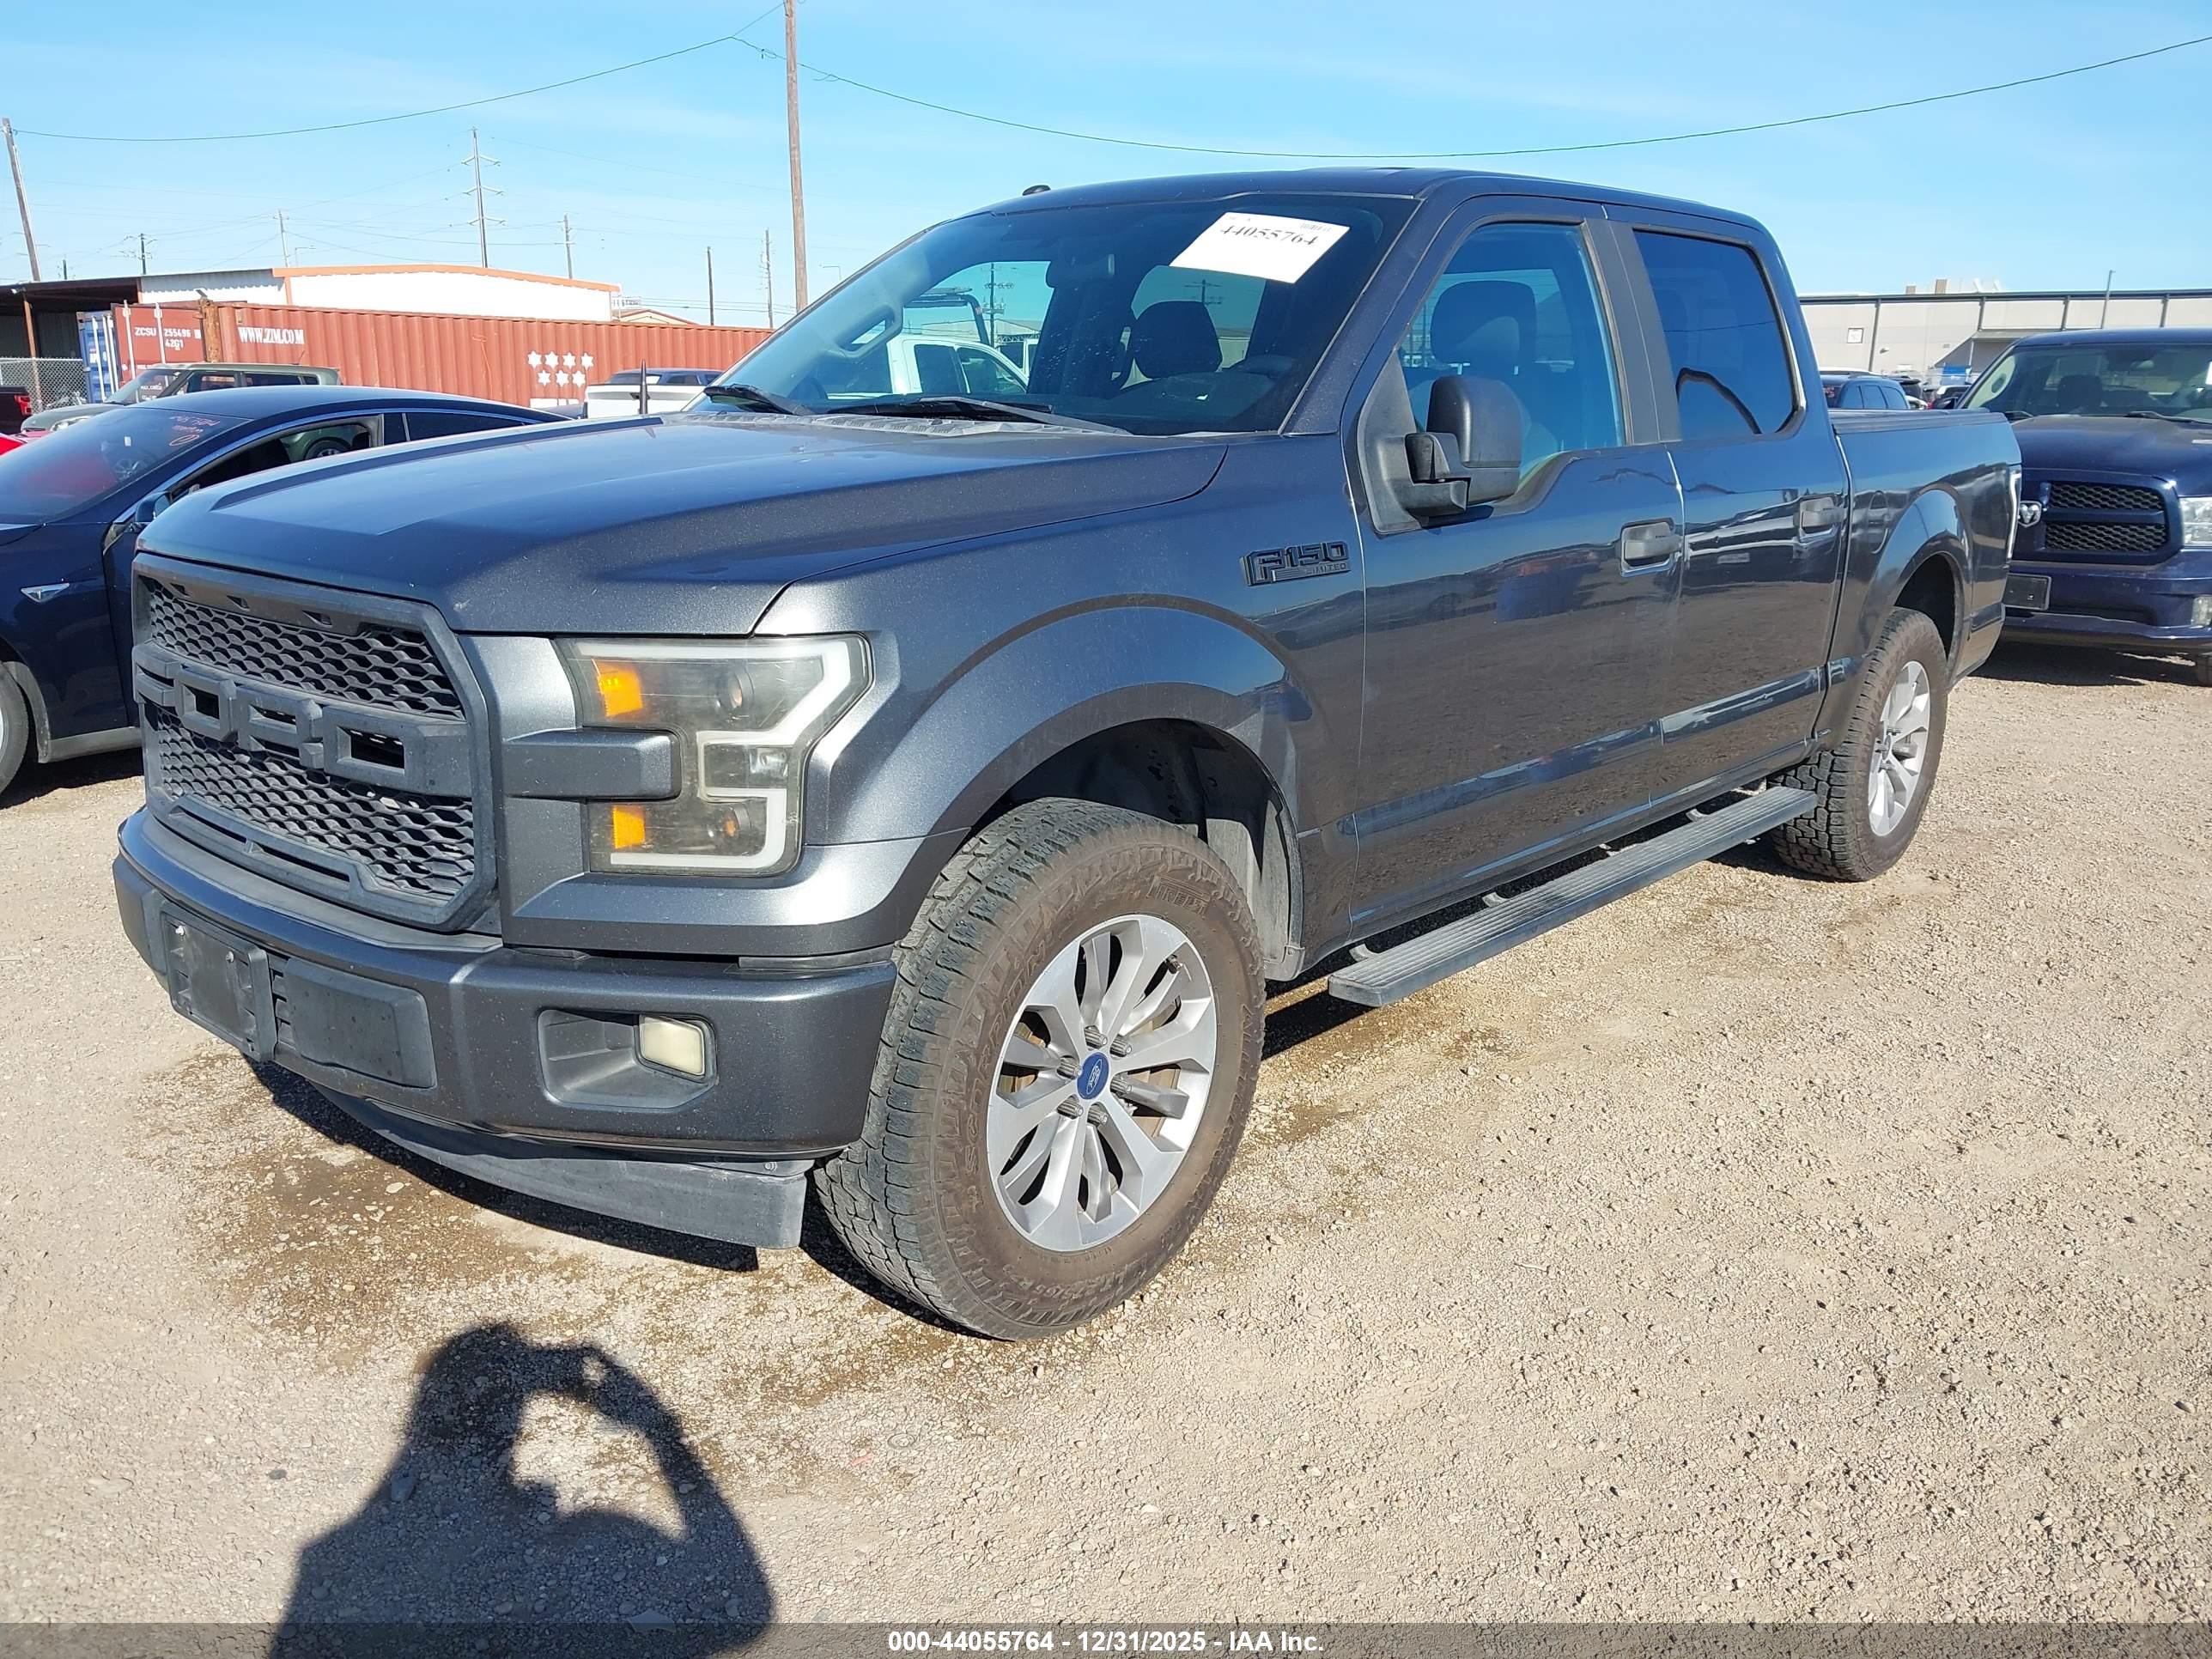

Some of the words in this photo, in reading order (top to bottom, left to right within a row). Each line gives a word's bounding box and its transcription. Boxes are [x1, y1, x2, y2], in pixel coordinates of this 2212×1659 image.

[1220, 225, 1319, 246] 44055764
[134, 326, 157, 337] ZCSU
[237, 326, 305, 344] WWW.ZIM.COM
[1305, 562, 1347, 575] LIMITED
[132, 639, 426, 788] FORD
